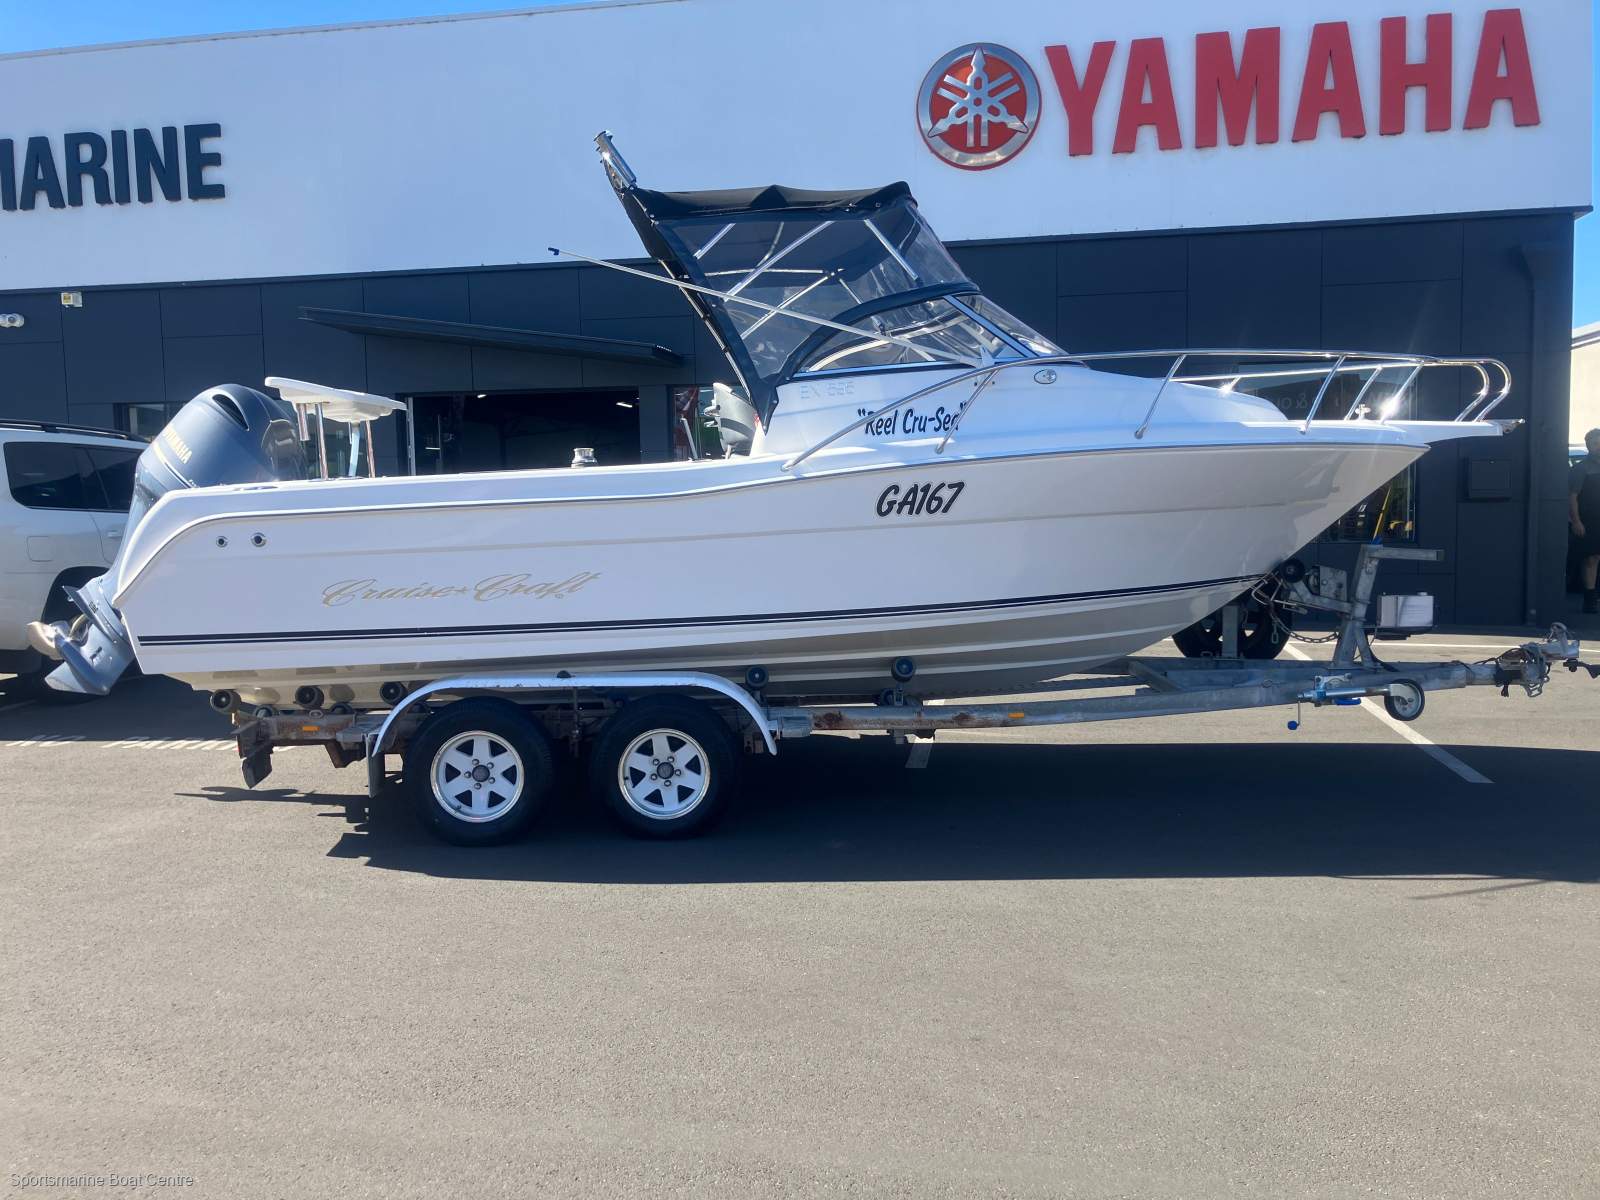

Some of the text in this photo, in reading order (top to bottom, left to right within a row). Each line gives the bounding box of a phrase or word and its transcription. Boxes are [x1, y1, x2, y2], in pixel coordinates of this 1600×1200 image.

[1044, 8, 1541, 156] YAMAHA
[877, 482, 965, 517] GA167
[322, 571, 602, 607] Cruise Craft
